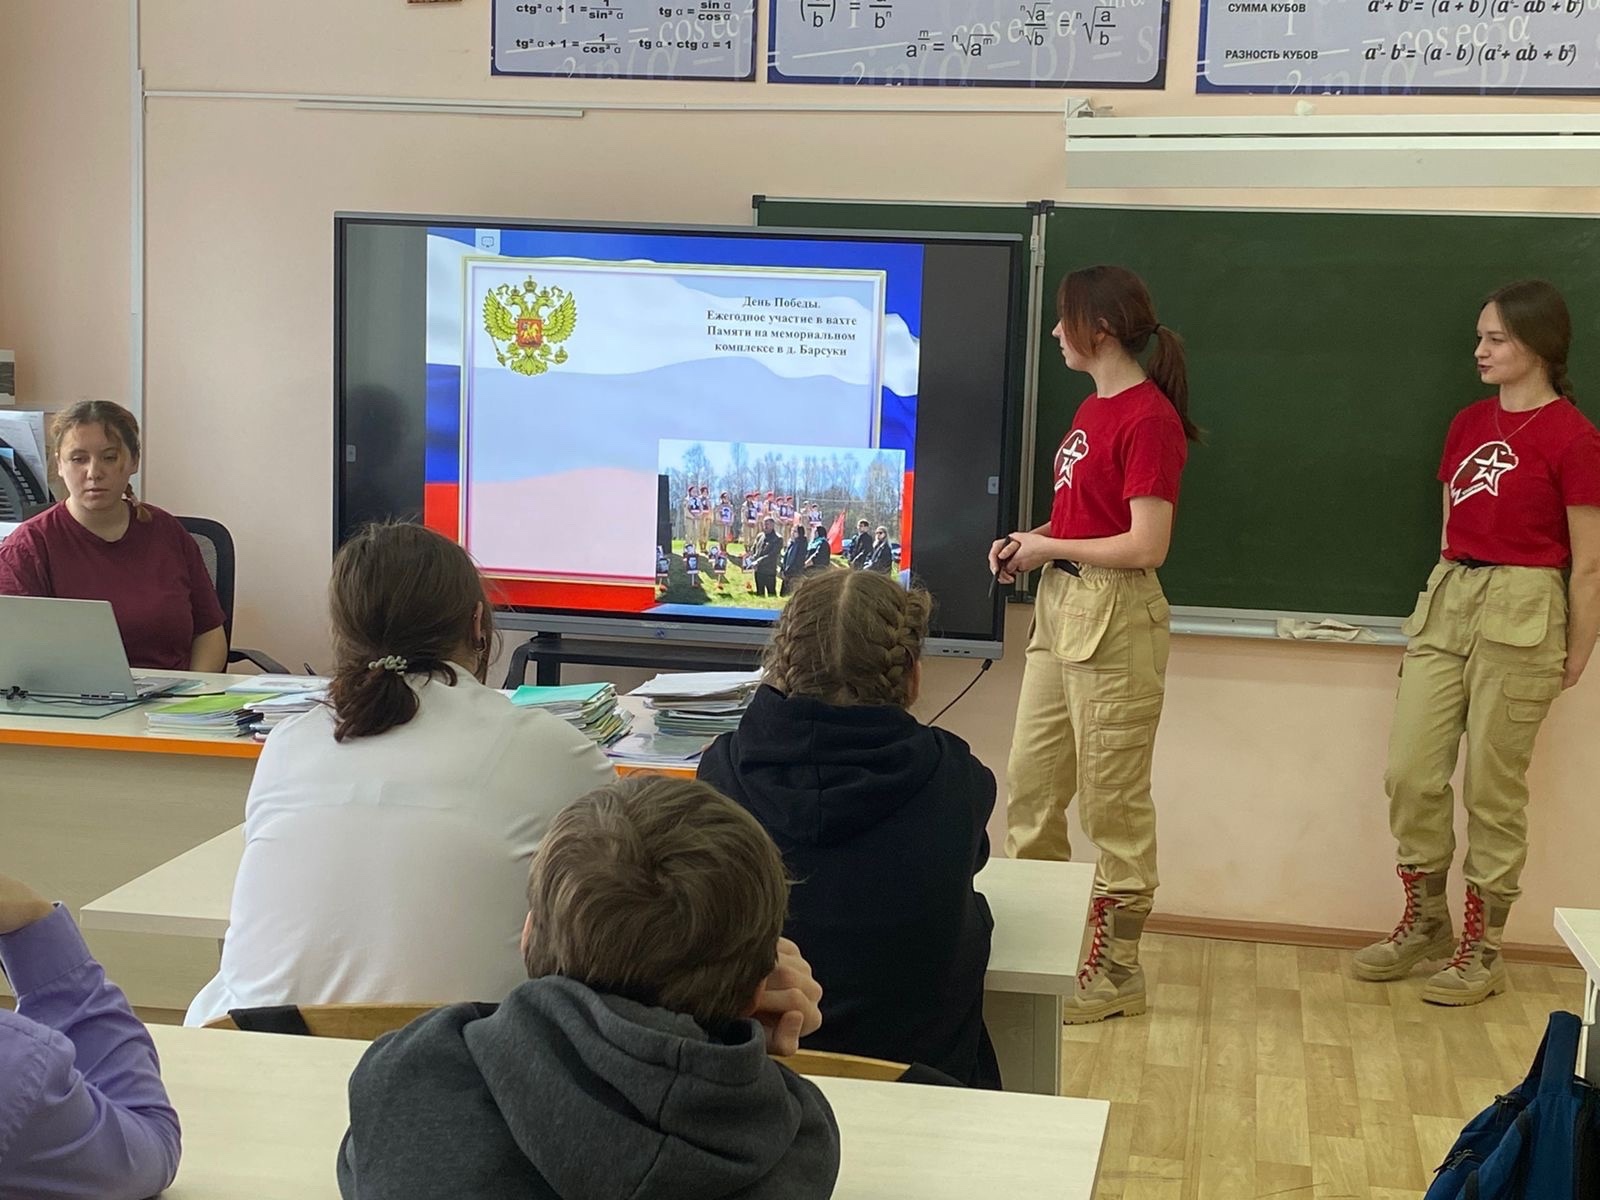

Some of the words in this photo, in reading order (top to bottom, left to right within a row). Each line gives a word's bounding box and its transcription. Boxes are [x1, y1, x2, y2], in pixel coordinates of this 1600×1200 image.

[569, 5, 575, 13] 1
[701, 0, 720, 9] sin
[1228, 3, 1268, 13] СУММА
[1271, 4, 1306, 13] КУБОВ
[659, 7, 672, 17] tg
[698, 13, 721, 21] cos
[599, 33, 605, 42] 1
[560, 40, 566, 48] 1
[639, 39, 652, 50] tg
[677, 40, 698, 51] ctg
[725, 40, 731, 49] 1
[1225, 50, 1280, 59] РАЗНОСТЬ
[1283, 50, 1318, 59] КУБОВ
[1516, 45, 1537, 61] ab
[742, 296, 771, 307] День
[775, 297, 821, 309] Победы.
[707, 310, 766, 322] Ежегодное
[768, 314, 813, 325] участие
[826, 317, 857, 326] вахте
[707, 325, 751, 337] Памяти
[771, 330, 856, 341] мемориальном
[715, 343, 774, 353] комплексе
[787, 346, 796, 355] д.
[800, 344, 847, 357] Барсуки
